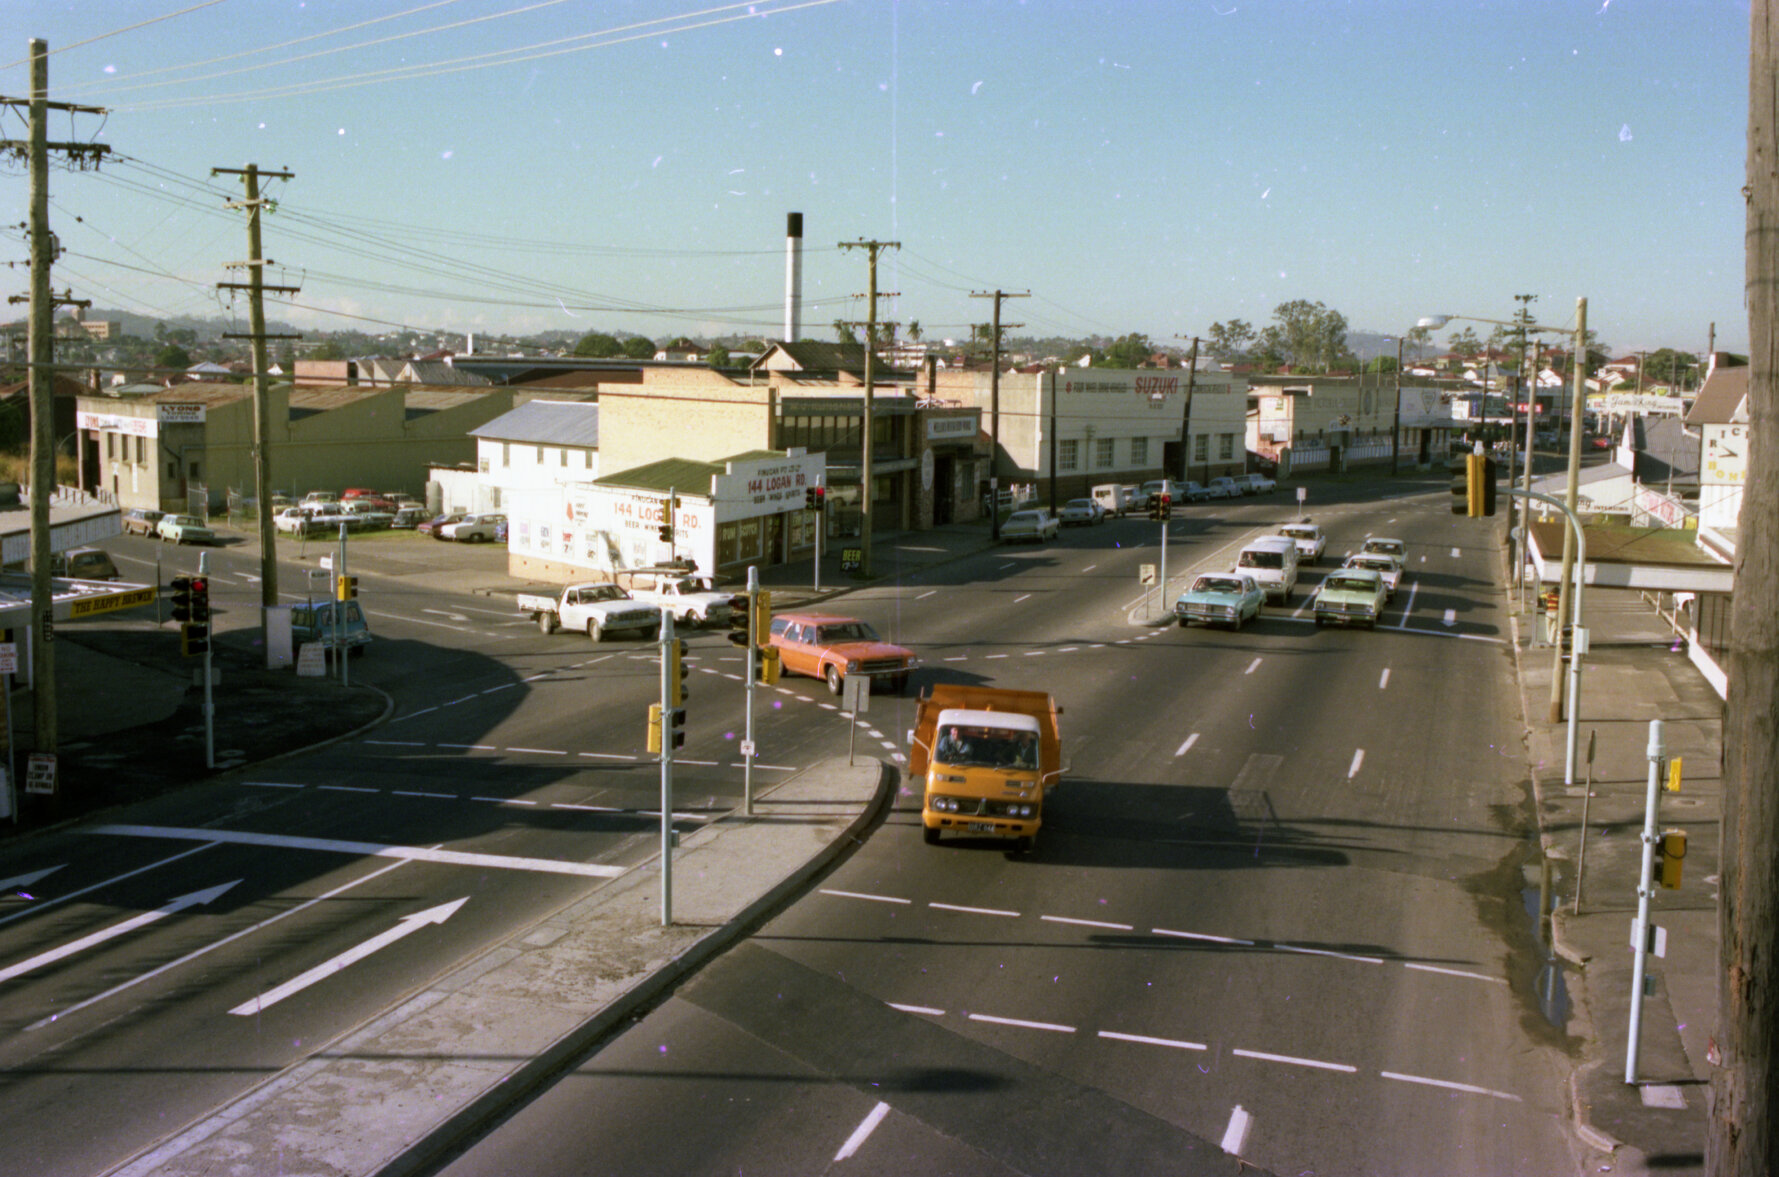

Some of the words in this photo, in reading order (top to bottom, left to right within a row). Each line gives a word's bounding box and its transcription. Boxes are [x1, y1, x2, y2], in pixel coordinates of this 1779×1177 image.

[1135, 375, 1178, 394] SUZUKI
[748, 479, 762, 494] 144
[766, 475, 791, 491] LOGAN
[614, 502, 632, 516] 144
[682, 513, 702, 529] RD.
[624, 520, 640, 528] BEER
[842, 549, 862, 561] BEER
[75, 602, 92, 614] THE
[93, 597, 119, 611] HAPPY
[122, 590, 153, 605] BREWER
